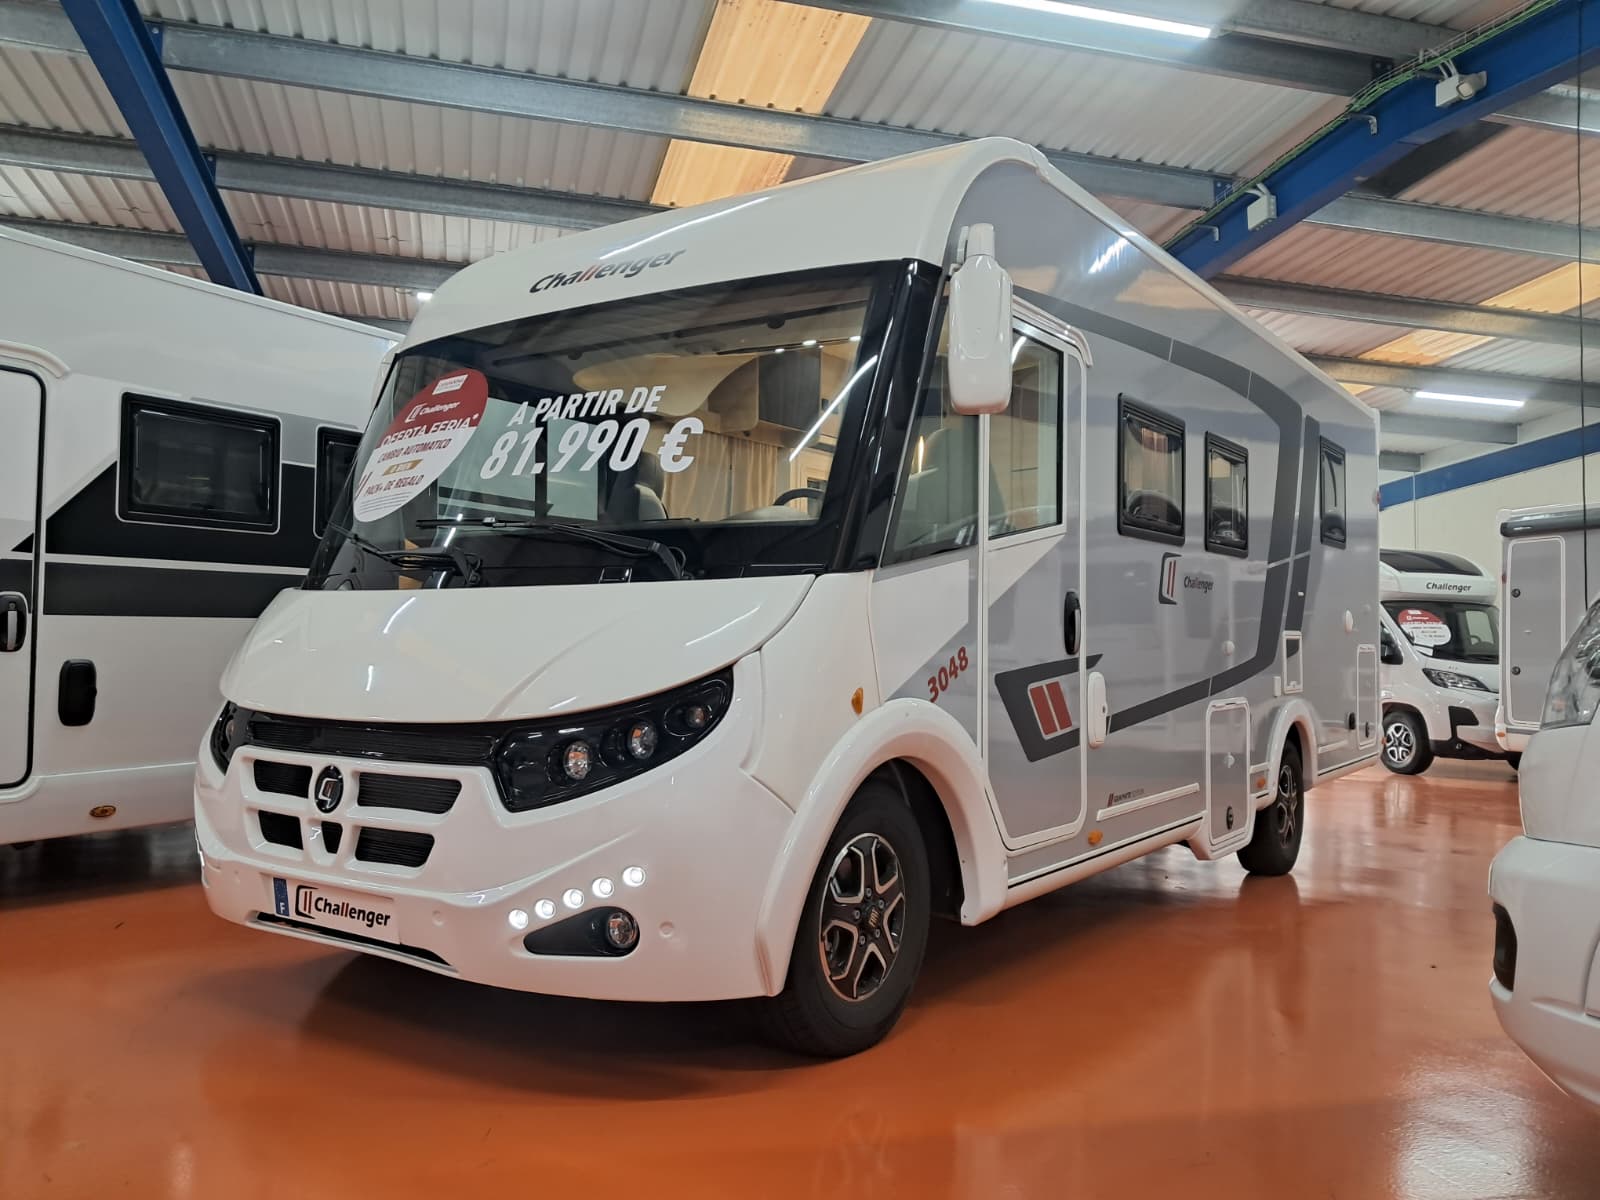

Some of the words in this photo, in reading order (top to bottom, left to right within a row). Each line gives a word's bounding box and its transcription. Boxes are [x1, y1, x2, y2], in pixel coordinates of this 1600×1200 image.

[529, 249, 687, 294] Challenger
[420, 401, 461, 416] Challenger
[506, 400, 529, 427] A
[530, 388, 624, 423] PARTIR
[624, 384, 667, 415] DE
[479, 417, 651, 480] 81.990
[657, 416, 704, 473] €
[1183, 575, 1214, 594] Challenger
[1425, 581, 1472, 593] Challenger
[927, 646, 969, 703] 3048
[314, 896, 391, 928] Challenger
